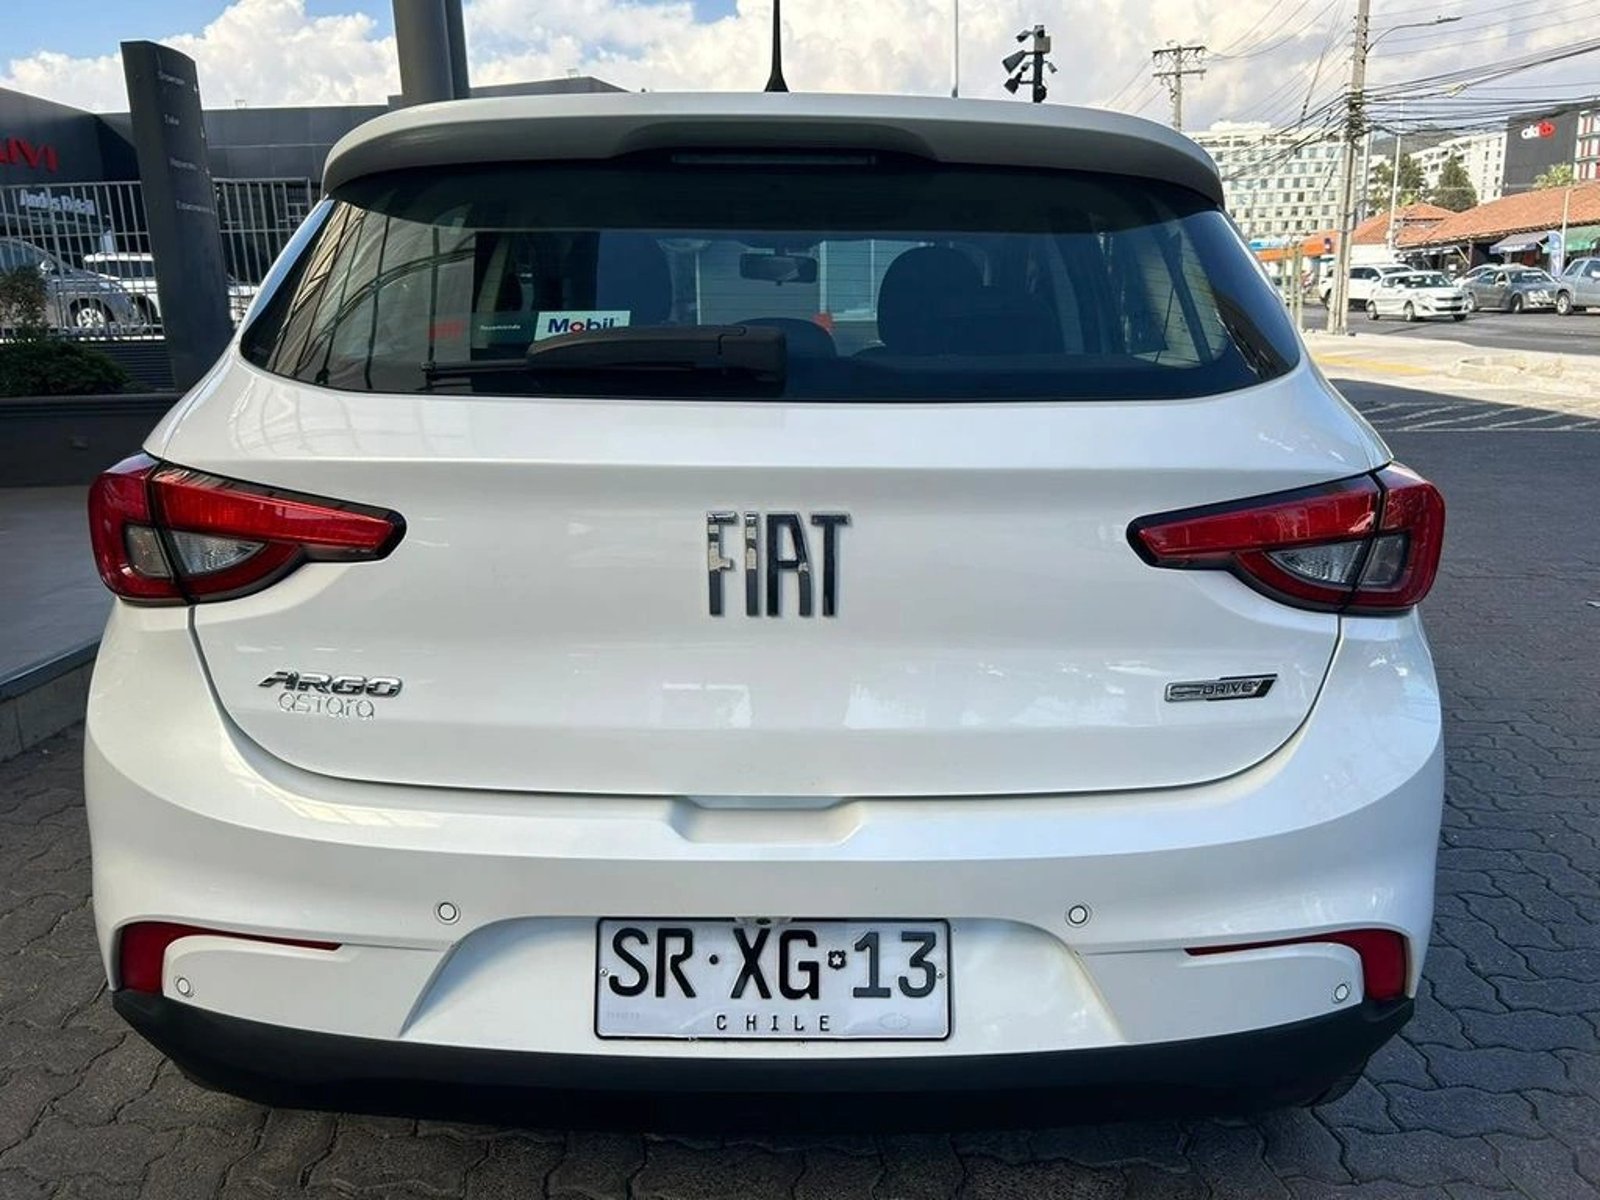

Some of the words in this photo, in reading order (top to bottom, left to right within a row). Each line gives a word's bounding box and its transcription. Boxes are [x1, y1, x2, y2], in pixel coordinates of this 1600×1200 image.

[547, 317, 615, 335] Mobil
[706, 511, 851, 618] FIAT
[258, 671, 403, 698] ARGO
[716, 1014, 832, 1032] CHILE
